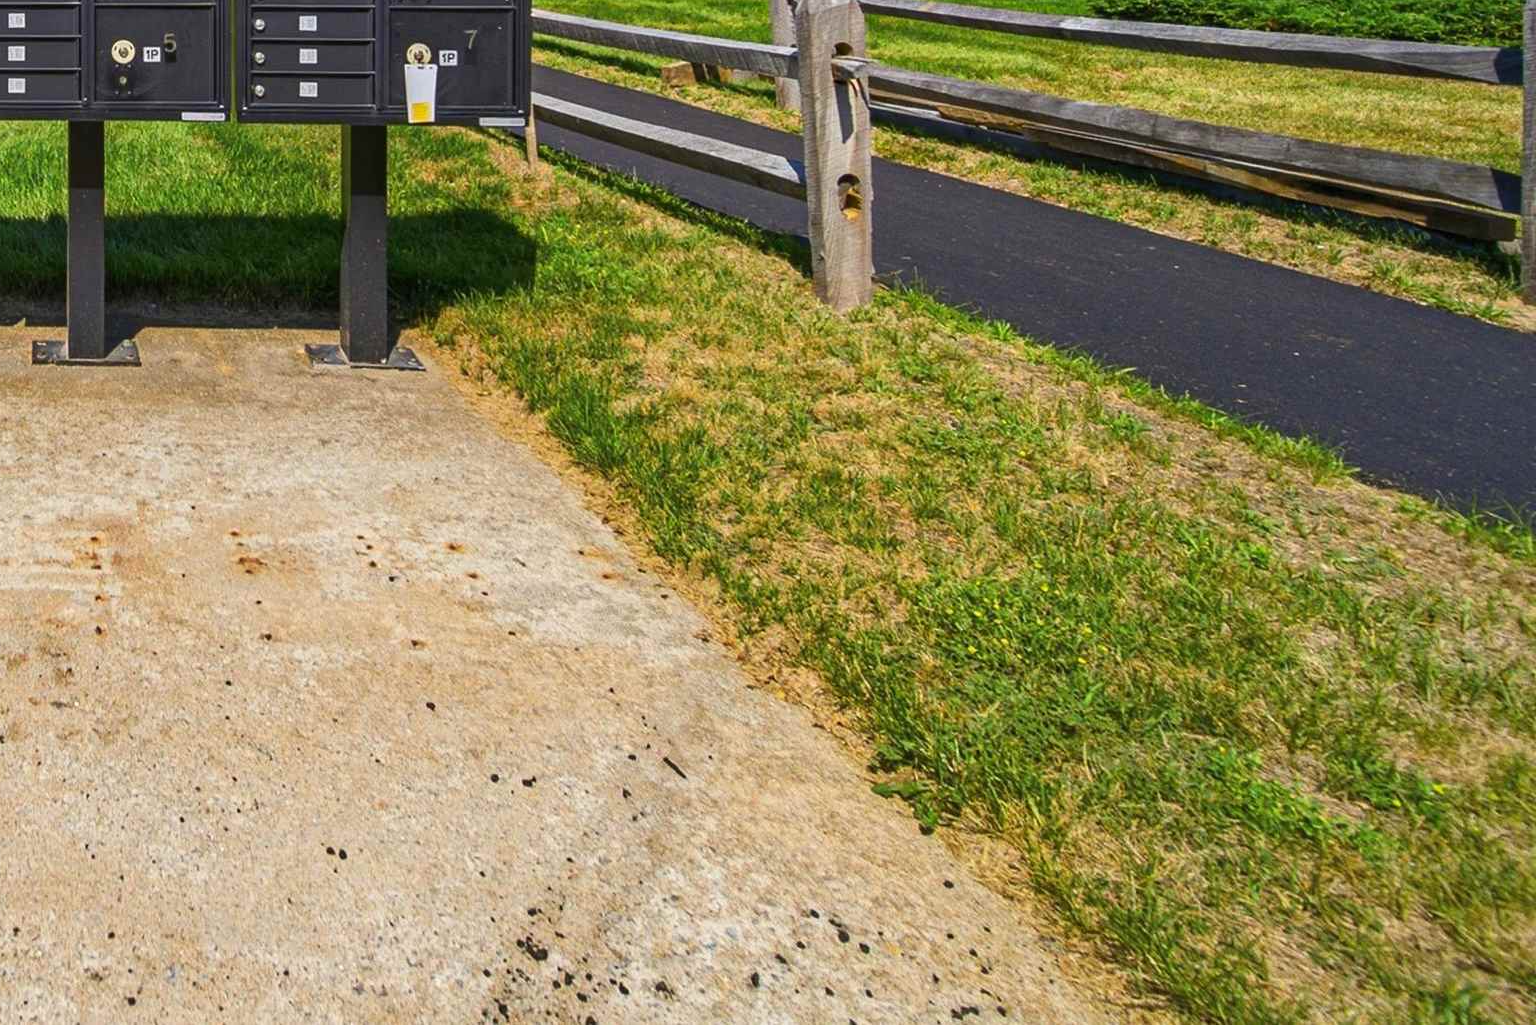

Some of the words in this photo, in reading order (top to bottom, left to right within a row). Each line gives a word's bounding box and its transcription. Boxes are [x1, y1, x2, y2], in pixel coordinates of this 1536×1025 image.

[164, 33, 177, 53] 5
[464, 30, 477, 50] 7
[146, 49, 159, 60] 1P
[442, 52, 455, 63] 1P
